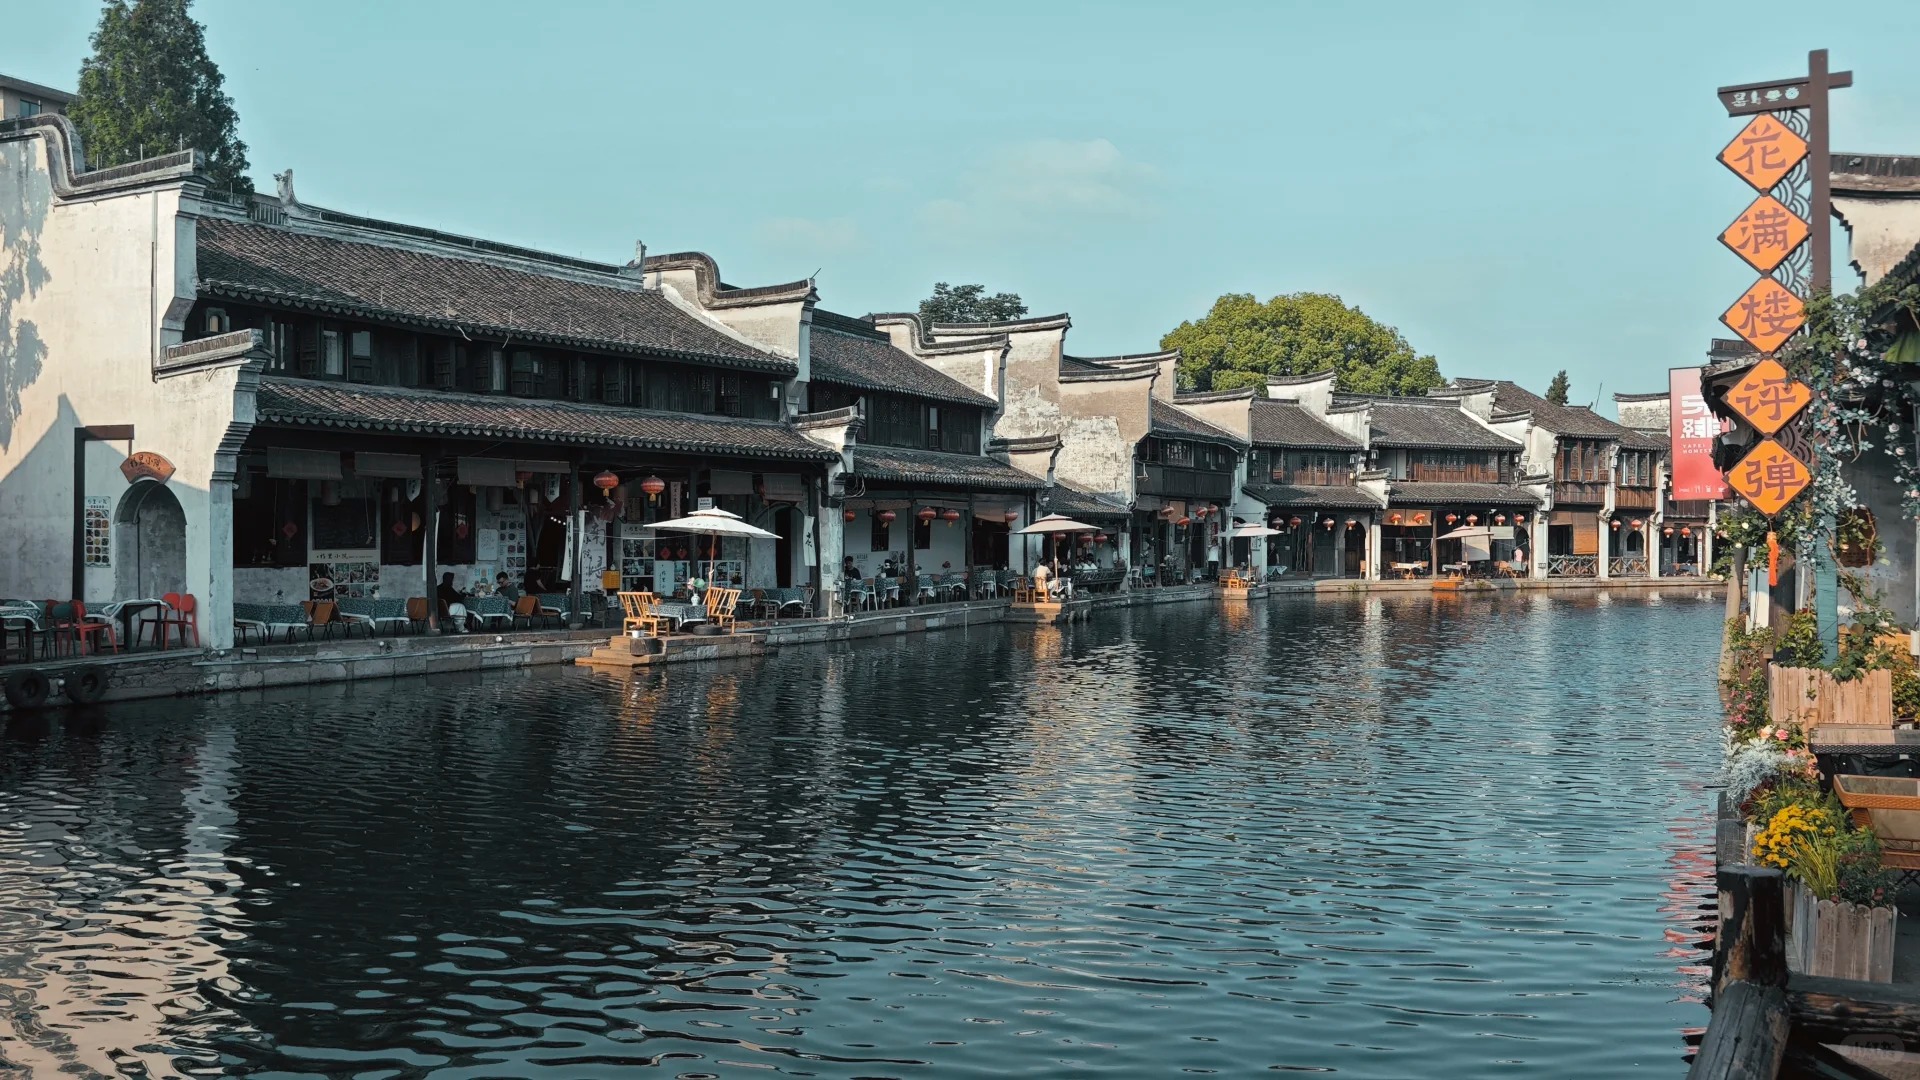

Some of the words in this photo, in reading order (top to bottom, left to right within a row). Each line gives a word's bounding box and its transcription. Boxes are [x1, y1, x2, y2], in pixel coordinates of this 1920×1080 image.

[1732, 123, 1806, 502] 花满楼评弹
